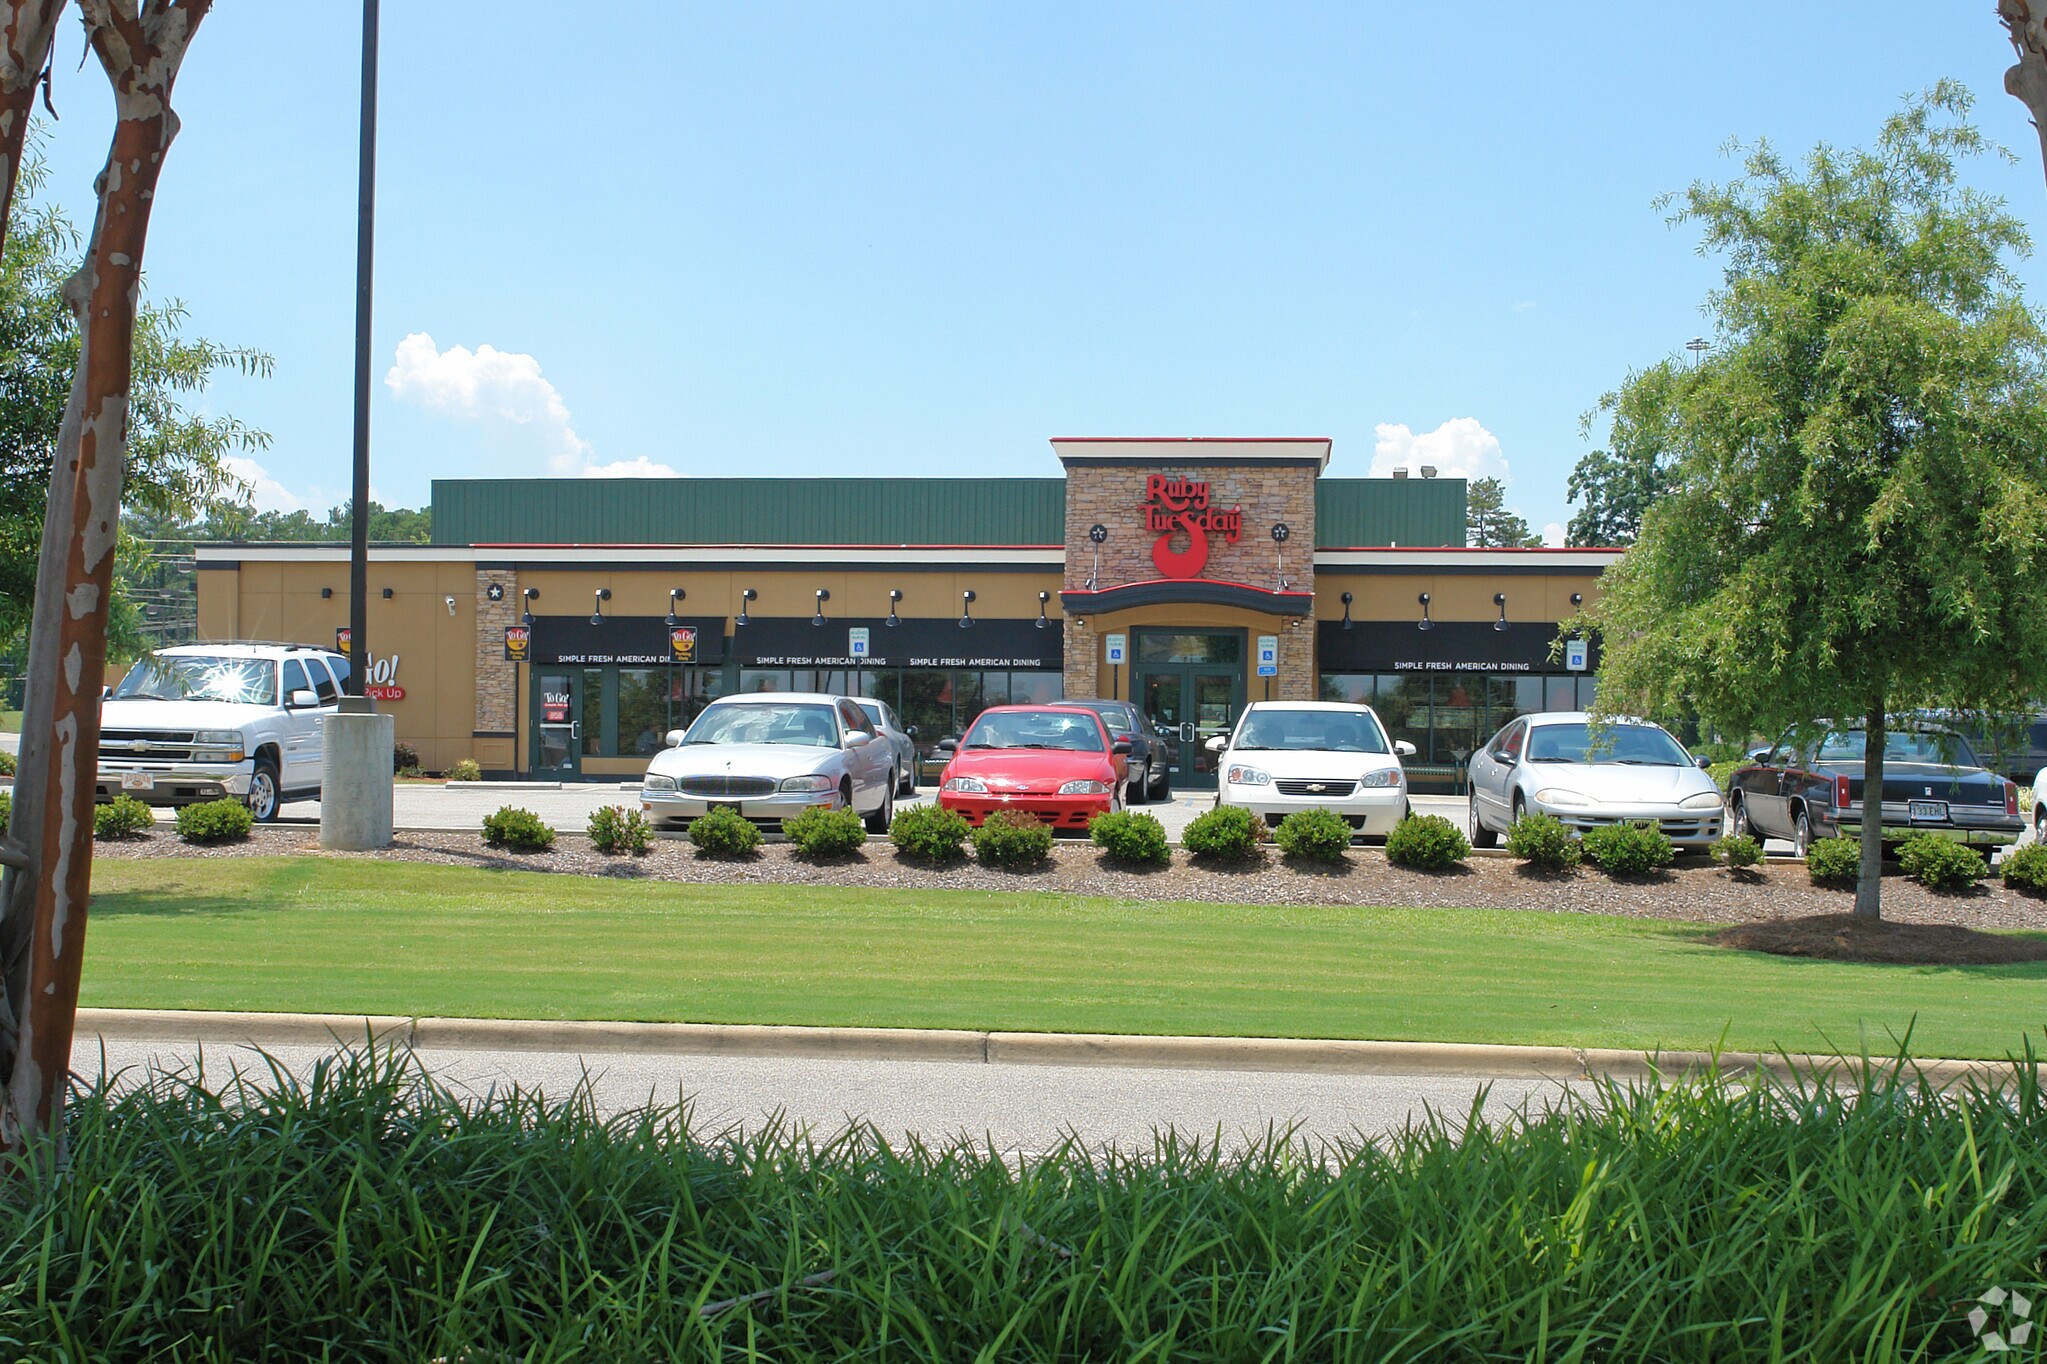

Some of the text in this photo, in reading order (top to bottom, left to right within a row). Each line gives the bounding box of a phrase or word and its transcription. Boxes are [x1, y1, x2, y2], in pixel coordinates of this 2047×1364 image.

[1146, 474, 1210, 512] Ruby
[1138, 503, 1242, 579] Tuesday
[558, 655, 586, 663] SIMPLE
[588, 655, 613, 663] FRESH
[616, 655, 657, 663] AMERICAN
[756, 656, 887, 665] SIMPLE FRESH AMERICAN DINING
[909, 657, 1041, 667] SIMPLE FRESH AMERICAN DINING
[1394, 661, 1530, 671] SIMPLE FRESH AMERICAN DINING
[386, 687, 402, 698] Up
[544, 692, 555, 703] To
